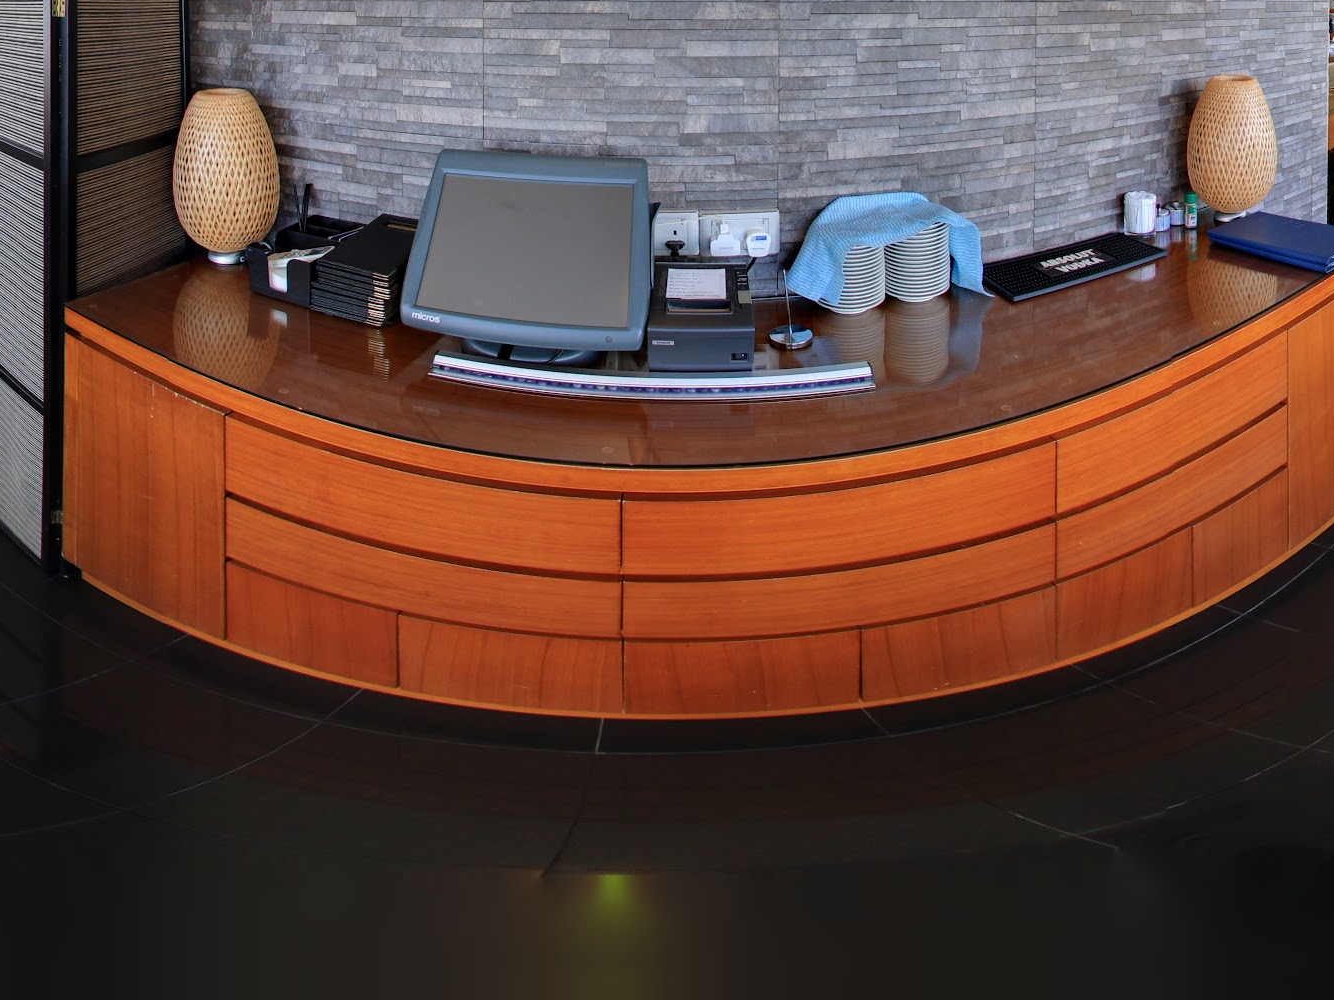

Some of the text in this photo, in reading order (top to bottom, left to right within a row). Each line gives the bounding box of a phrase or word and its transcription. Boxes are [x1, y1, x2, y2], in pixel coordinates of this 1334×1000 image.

[1040, 248, 1095, 268] ABSOLUT
[1054, 256, 1105, 273] VODKA
[411, 311, 440, 324] micros
